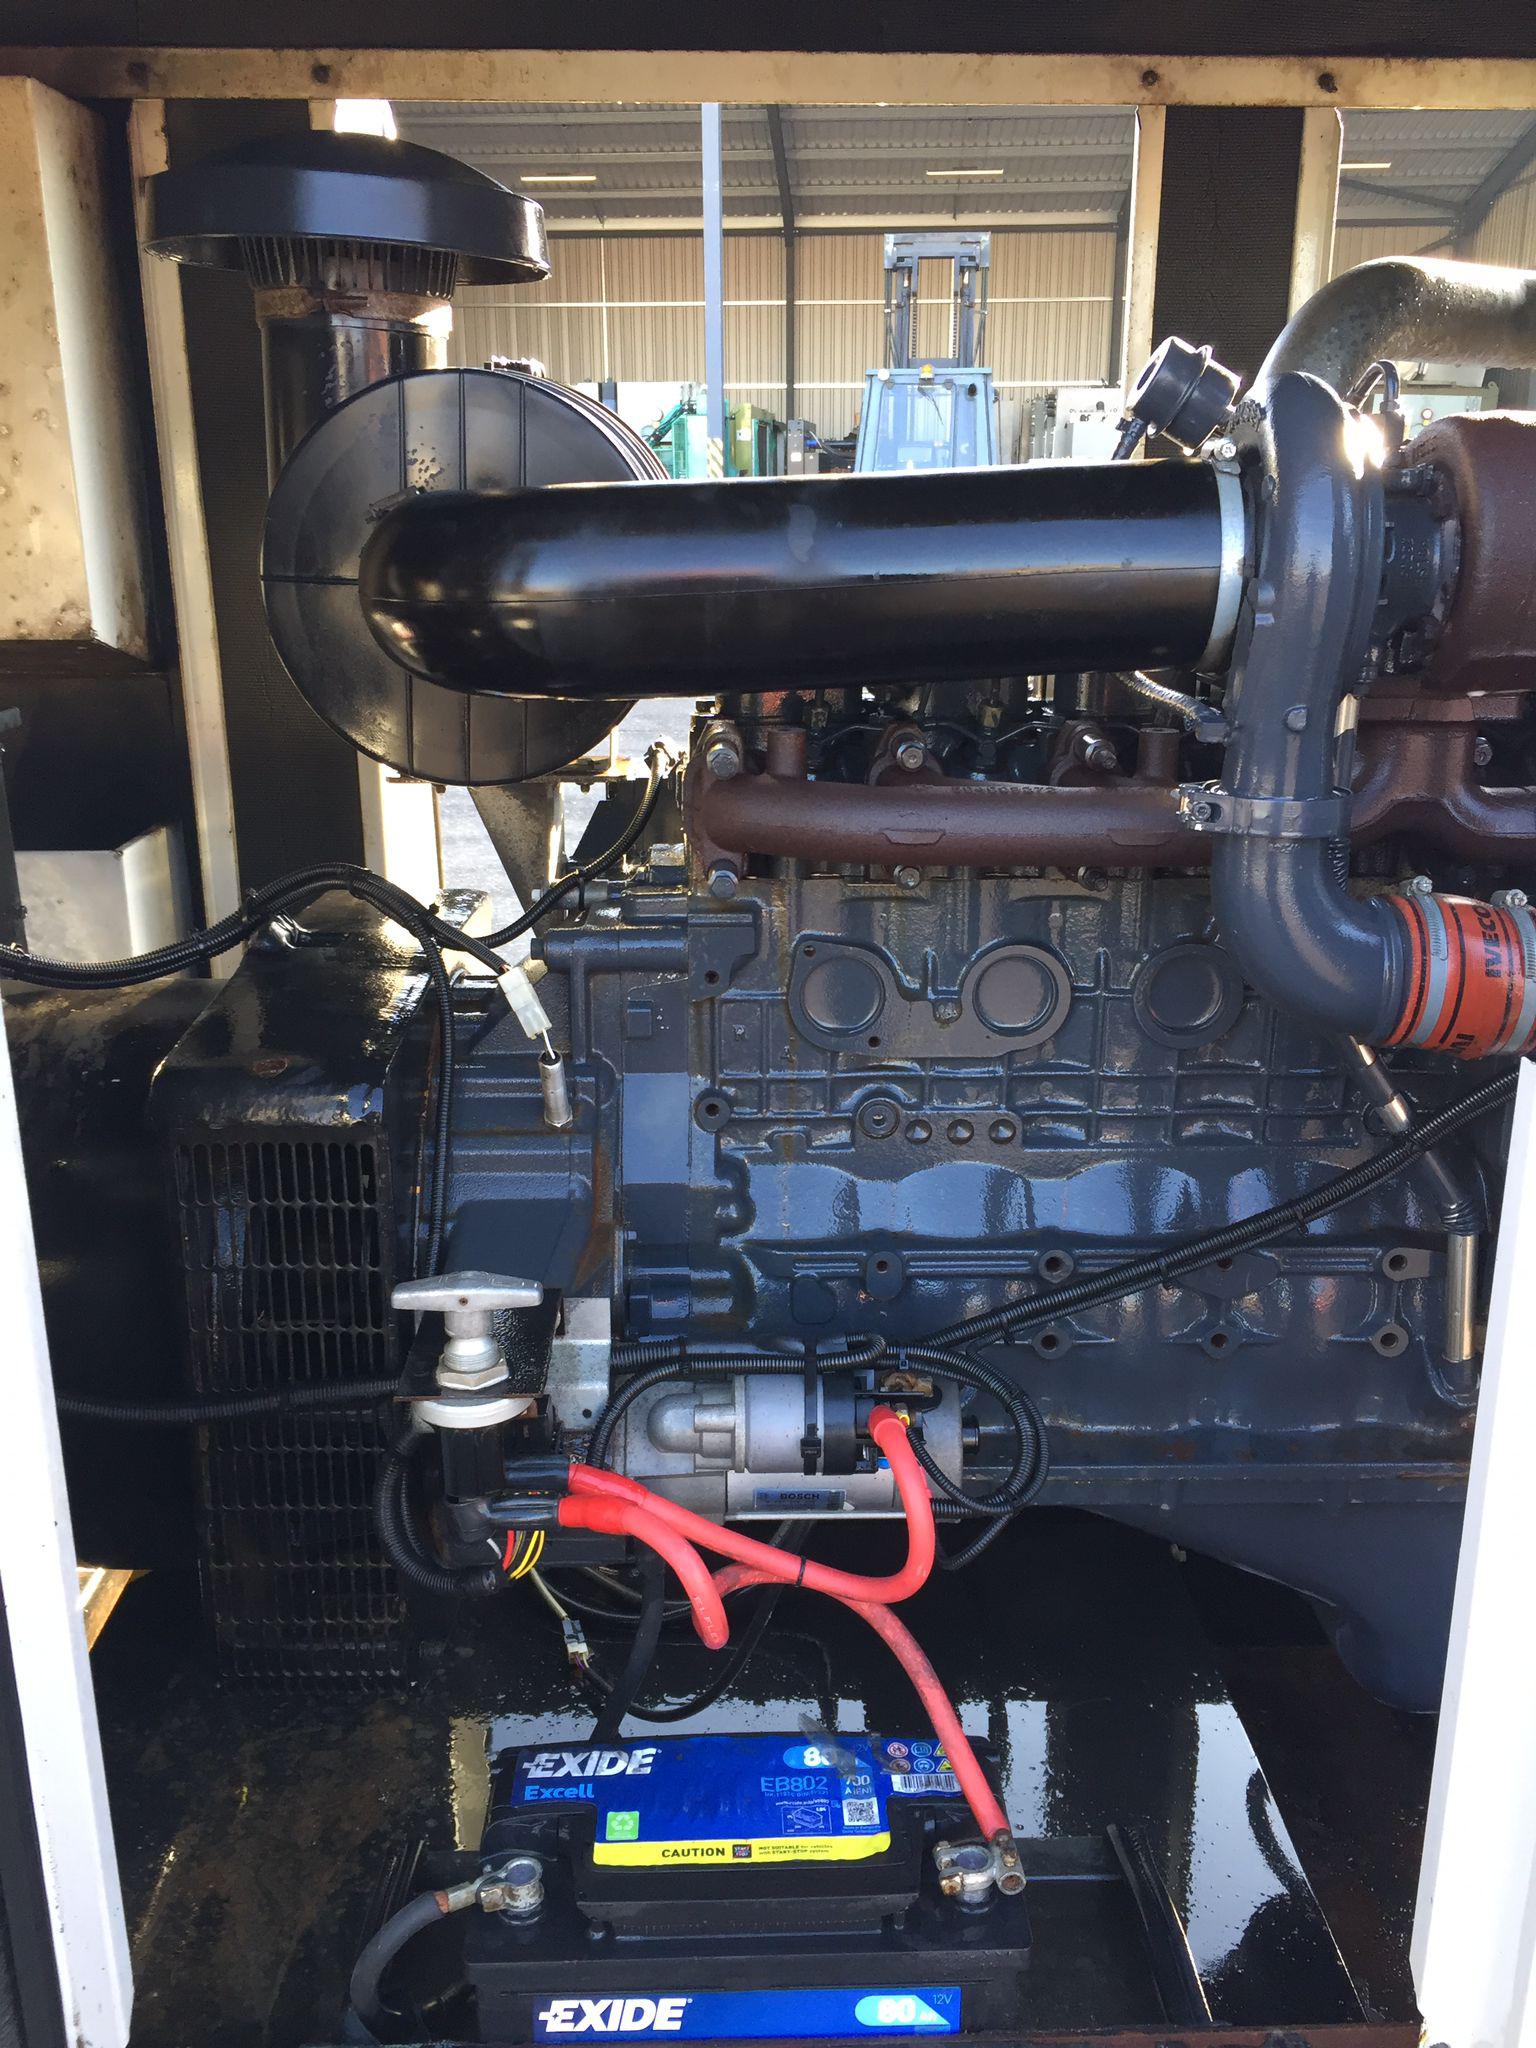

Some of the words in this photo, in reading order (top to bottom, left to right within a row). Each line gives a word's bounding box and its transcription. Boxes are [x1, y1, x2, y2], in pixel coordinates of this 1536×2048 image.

[1472, 905, 1502, 978] IVECO
[522, 1748, 658, 1779] EXIDE
[524, 1783, 595, 1801] Excell
[760, 1775, 828, 1793] EB802
[661, 1847, 726, 1858] CAUTION
[932, 1993, 953, 2005] 12V
[538, 1998, 688, 2032] EXIDE
[877, 1998, 916, 2024] 80
